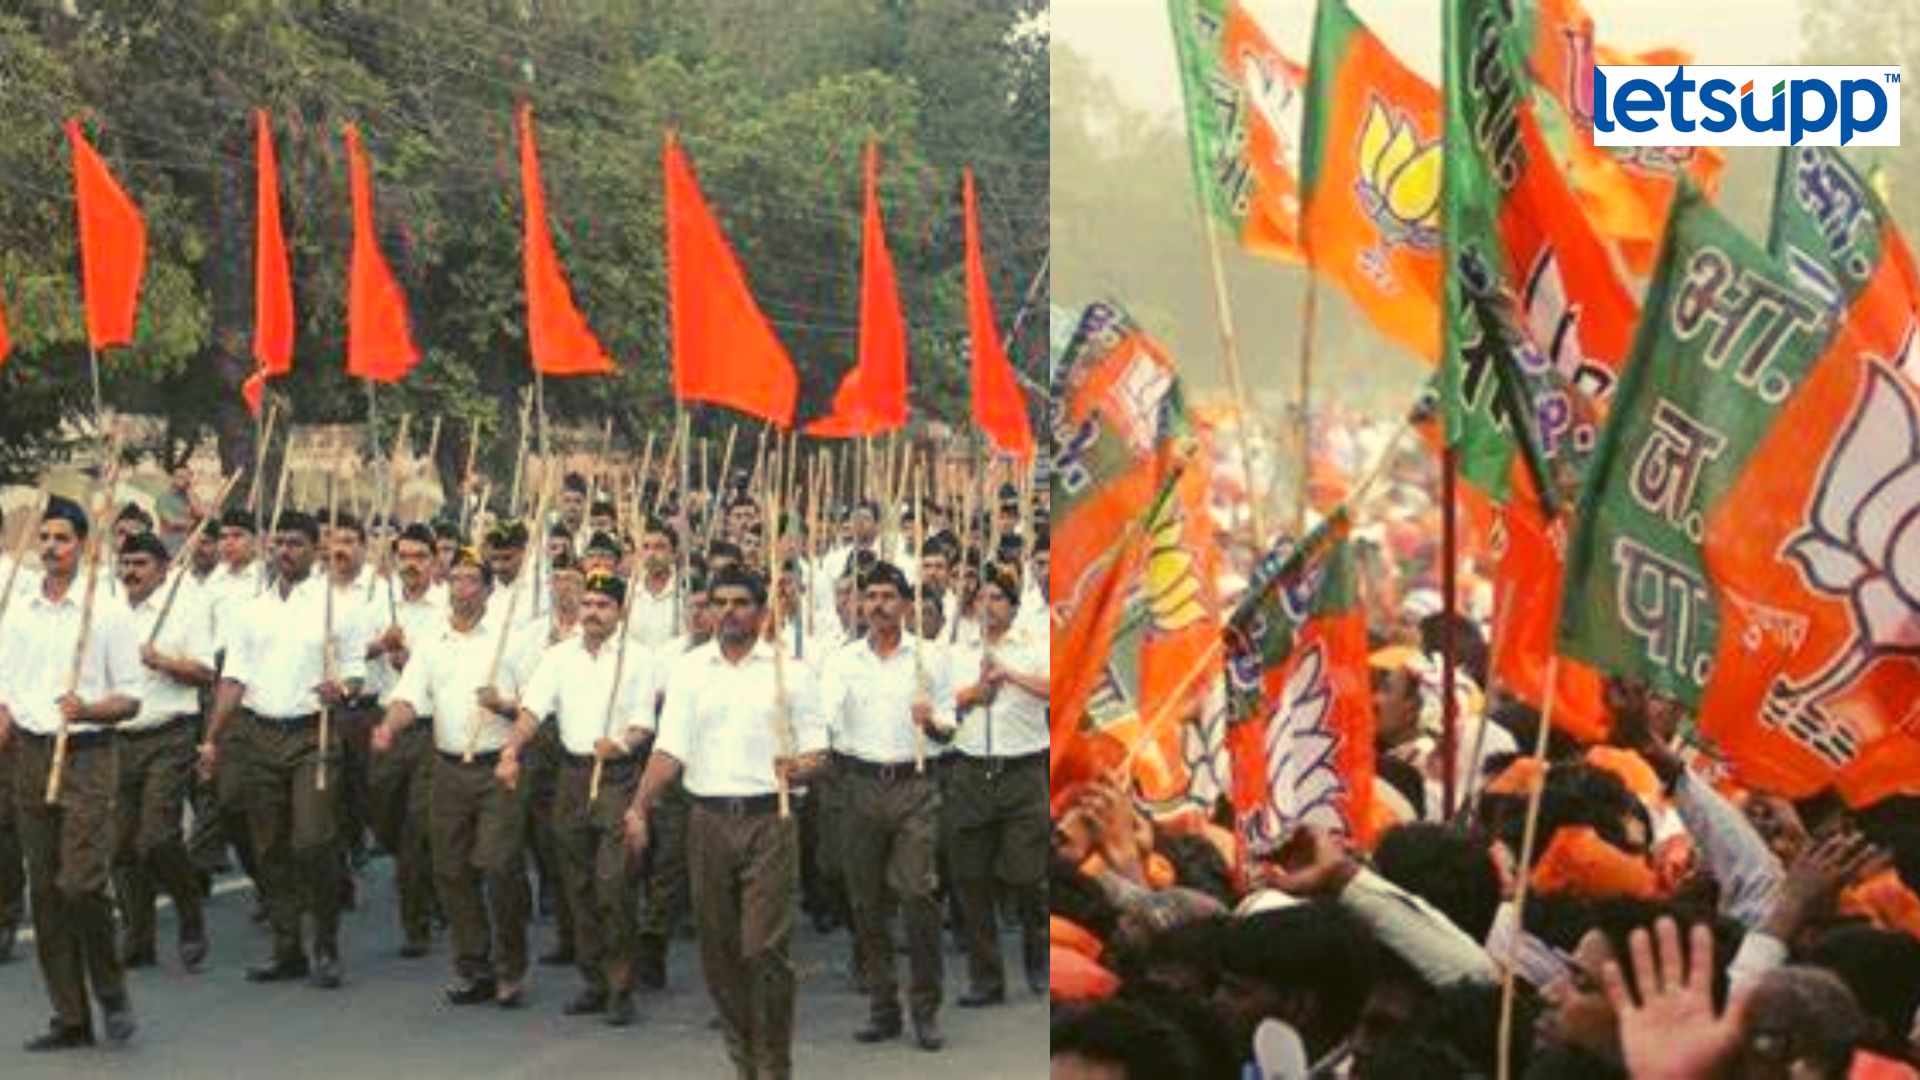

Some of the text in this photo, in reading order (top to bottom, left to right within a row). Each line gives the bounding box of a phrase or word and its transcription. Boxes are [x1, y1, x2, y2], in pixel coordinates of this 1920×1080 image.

[1672, 246, 1829, 403] भा.
[1629, 397, 1729, 544] ज.
[1613, 535, 1713, 686] पा.
